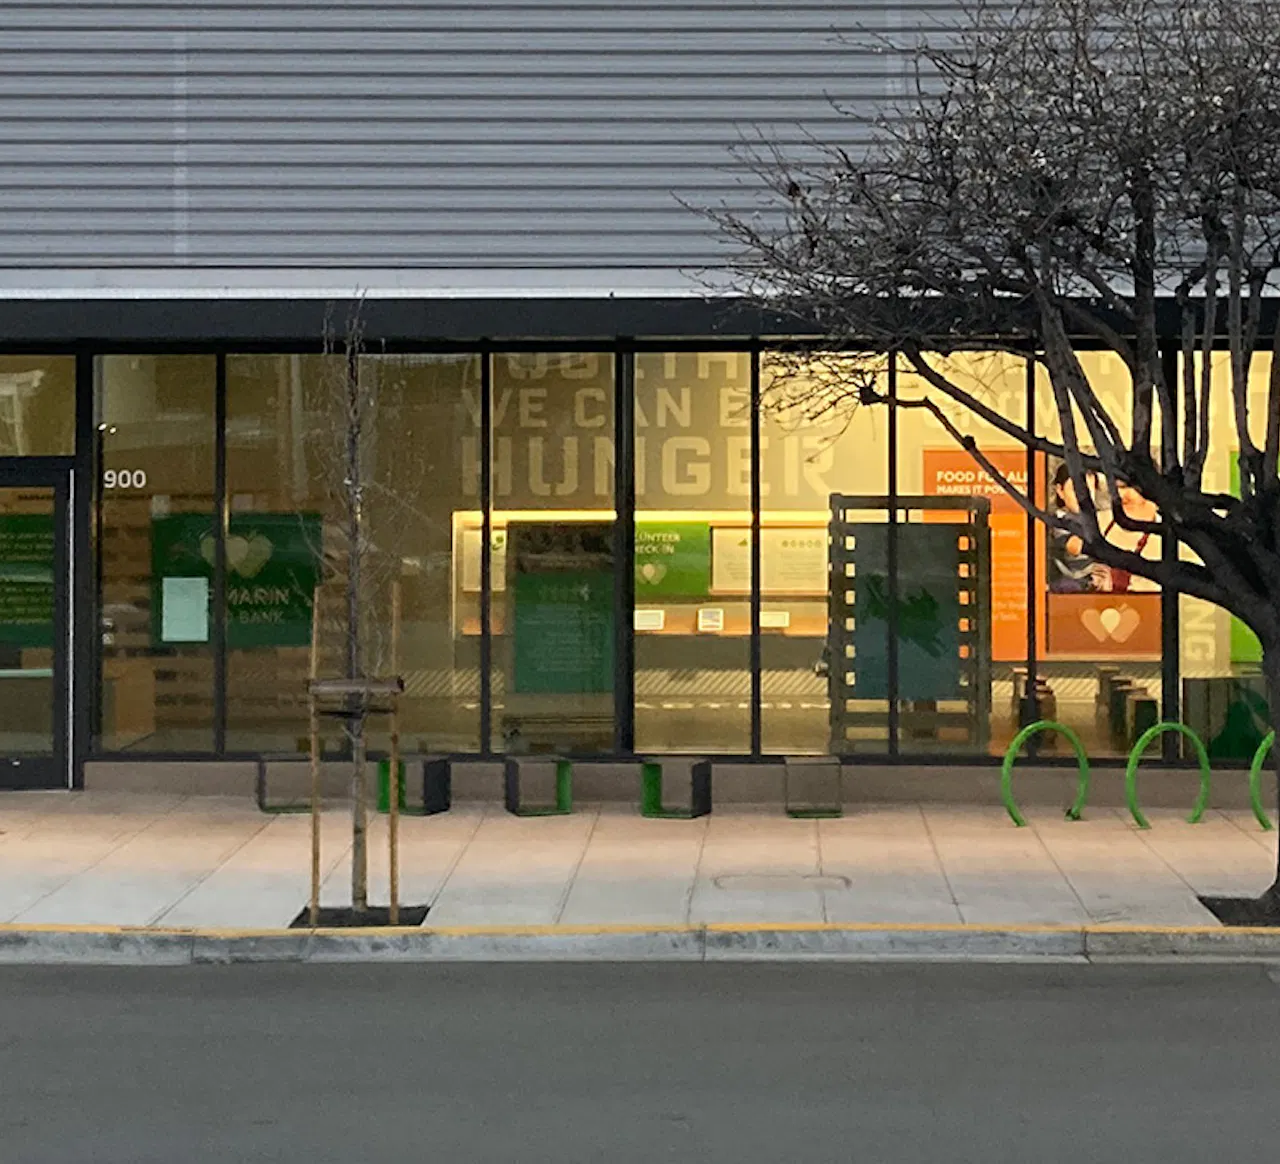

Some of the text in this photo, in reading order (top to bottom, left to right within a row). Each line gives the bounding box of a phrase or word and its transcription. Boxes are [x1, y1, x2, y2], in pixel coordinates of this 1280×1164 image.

[461, 388, 548, 427] WE
[461, 436, 834, 497] HUNGER
[936, 470, 976, 483] FOOD
[978, 470, 1005, 483] FO
[103, 469, 148, 489] 900
[936, 484, 971, 495] MAKES
